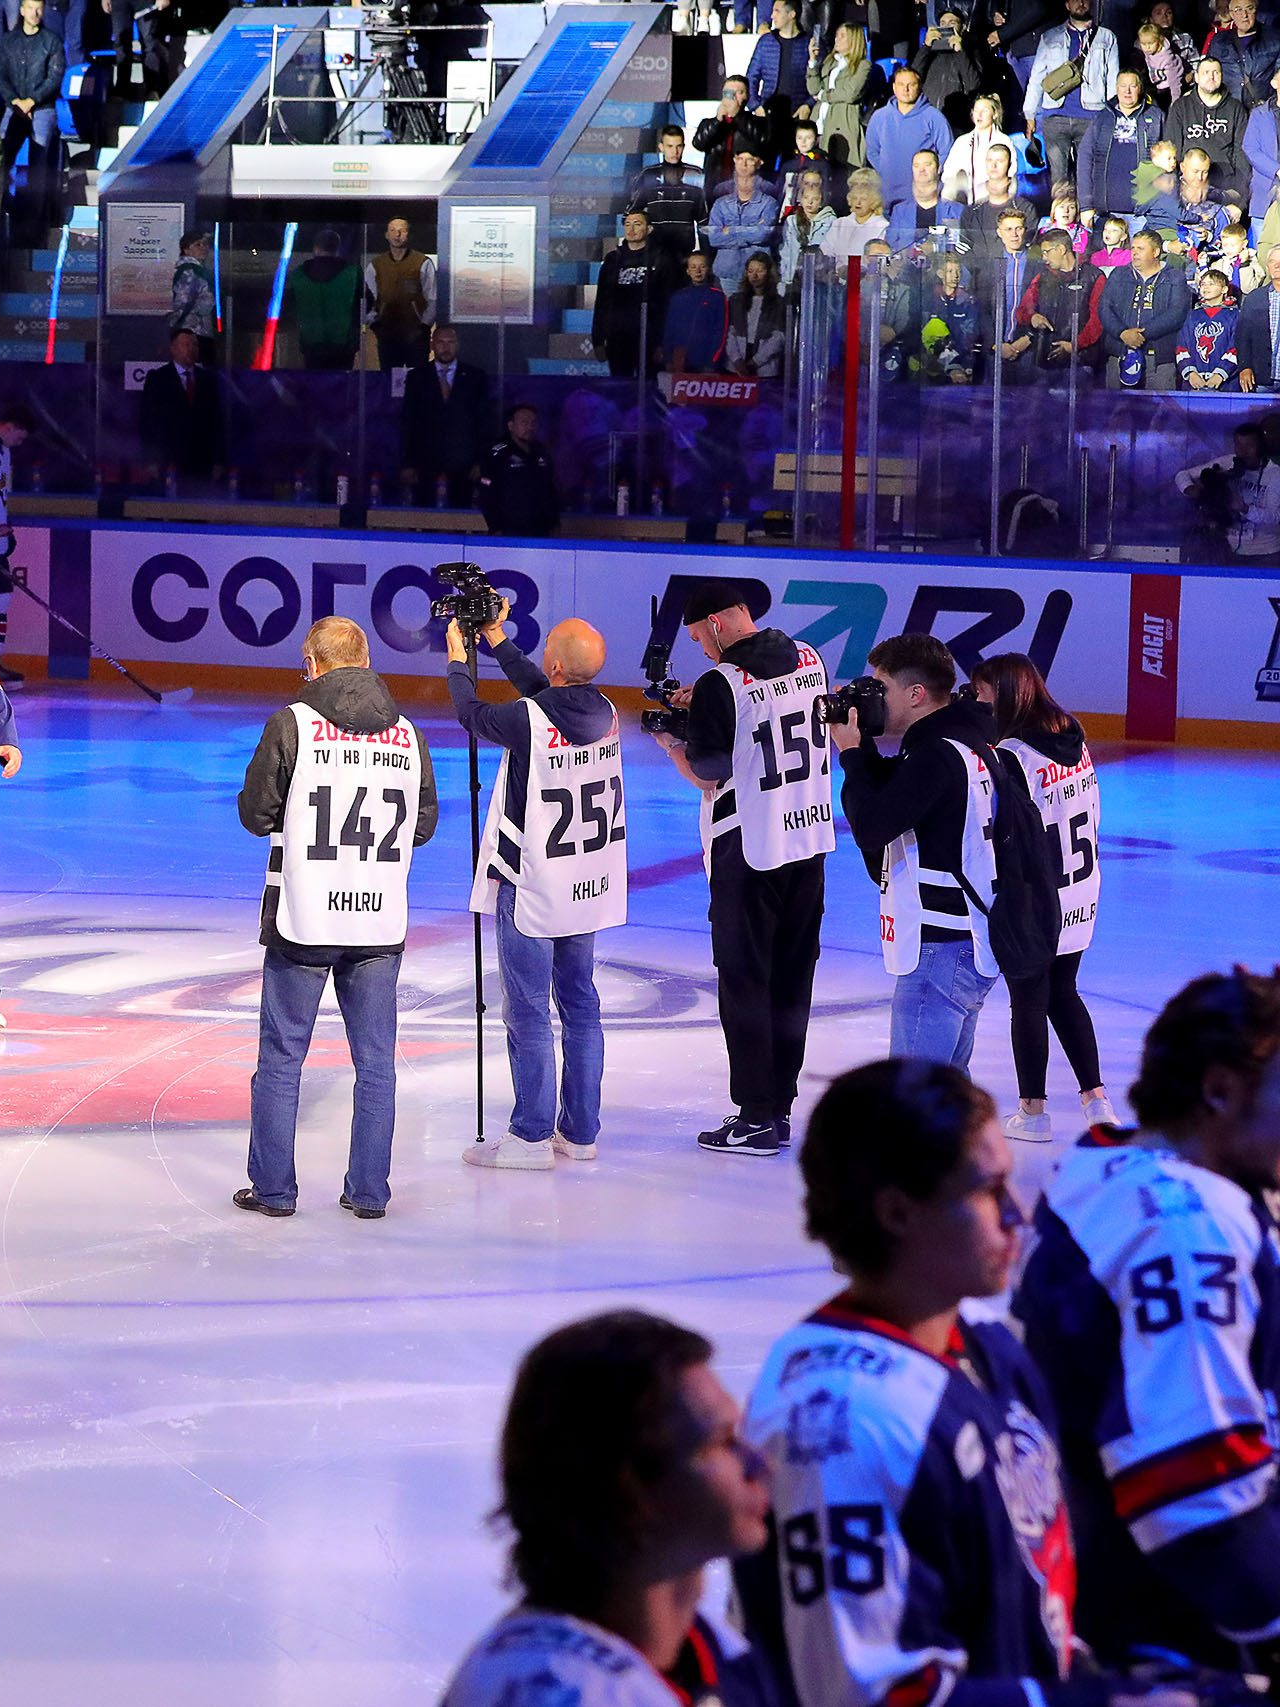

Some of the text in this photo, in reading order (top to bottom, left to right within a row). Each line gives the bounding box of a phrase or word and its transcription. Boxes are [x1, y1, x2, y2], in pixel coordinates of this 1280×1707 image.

[473, 240, 508, 250] Маркет
[45, 298, 85, 308] OEANIS
[30, 320, 70, 331] OCENIS
[673, 380, 757, 400] FONBET
[747, 671, 824, 705] TV HB PHOTO
[313, 749, 411, 771] TV HB PHOTO
[548, 742, 620, 770] TV HB PHOT
[1062, 783, 1076, 801] HB
[306, 785, 409, 863] 142
[540, 774, 626, 860] 252
[1045, 804, 1099, 890] 15
[1062, 902, 1097, 929] KHL.R
[1130, 1251, 1238, 1333] 83
[785, 1504, 885, 1605] 88
